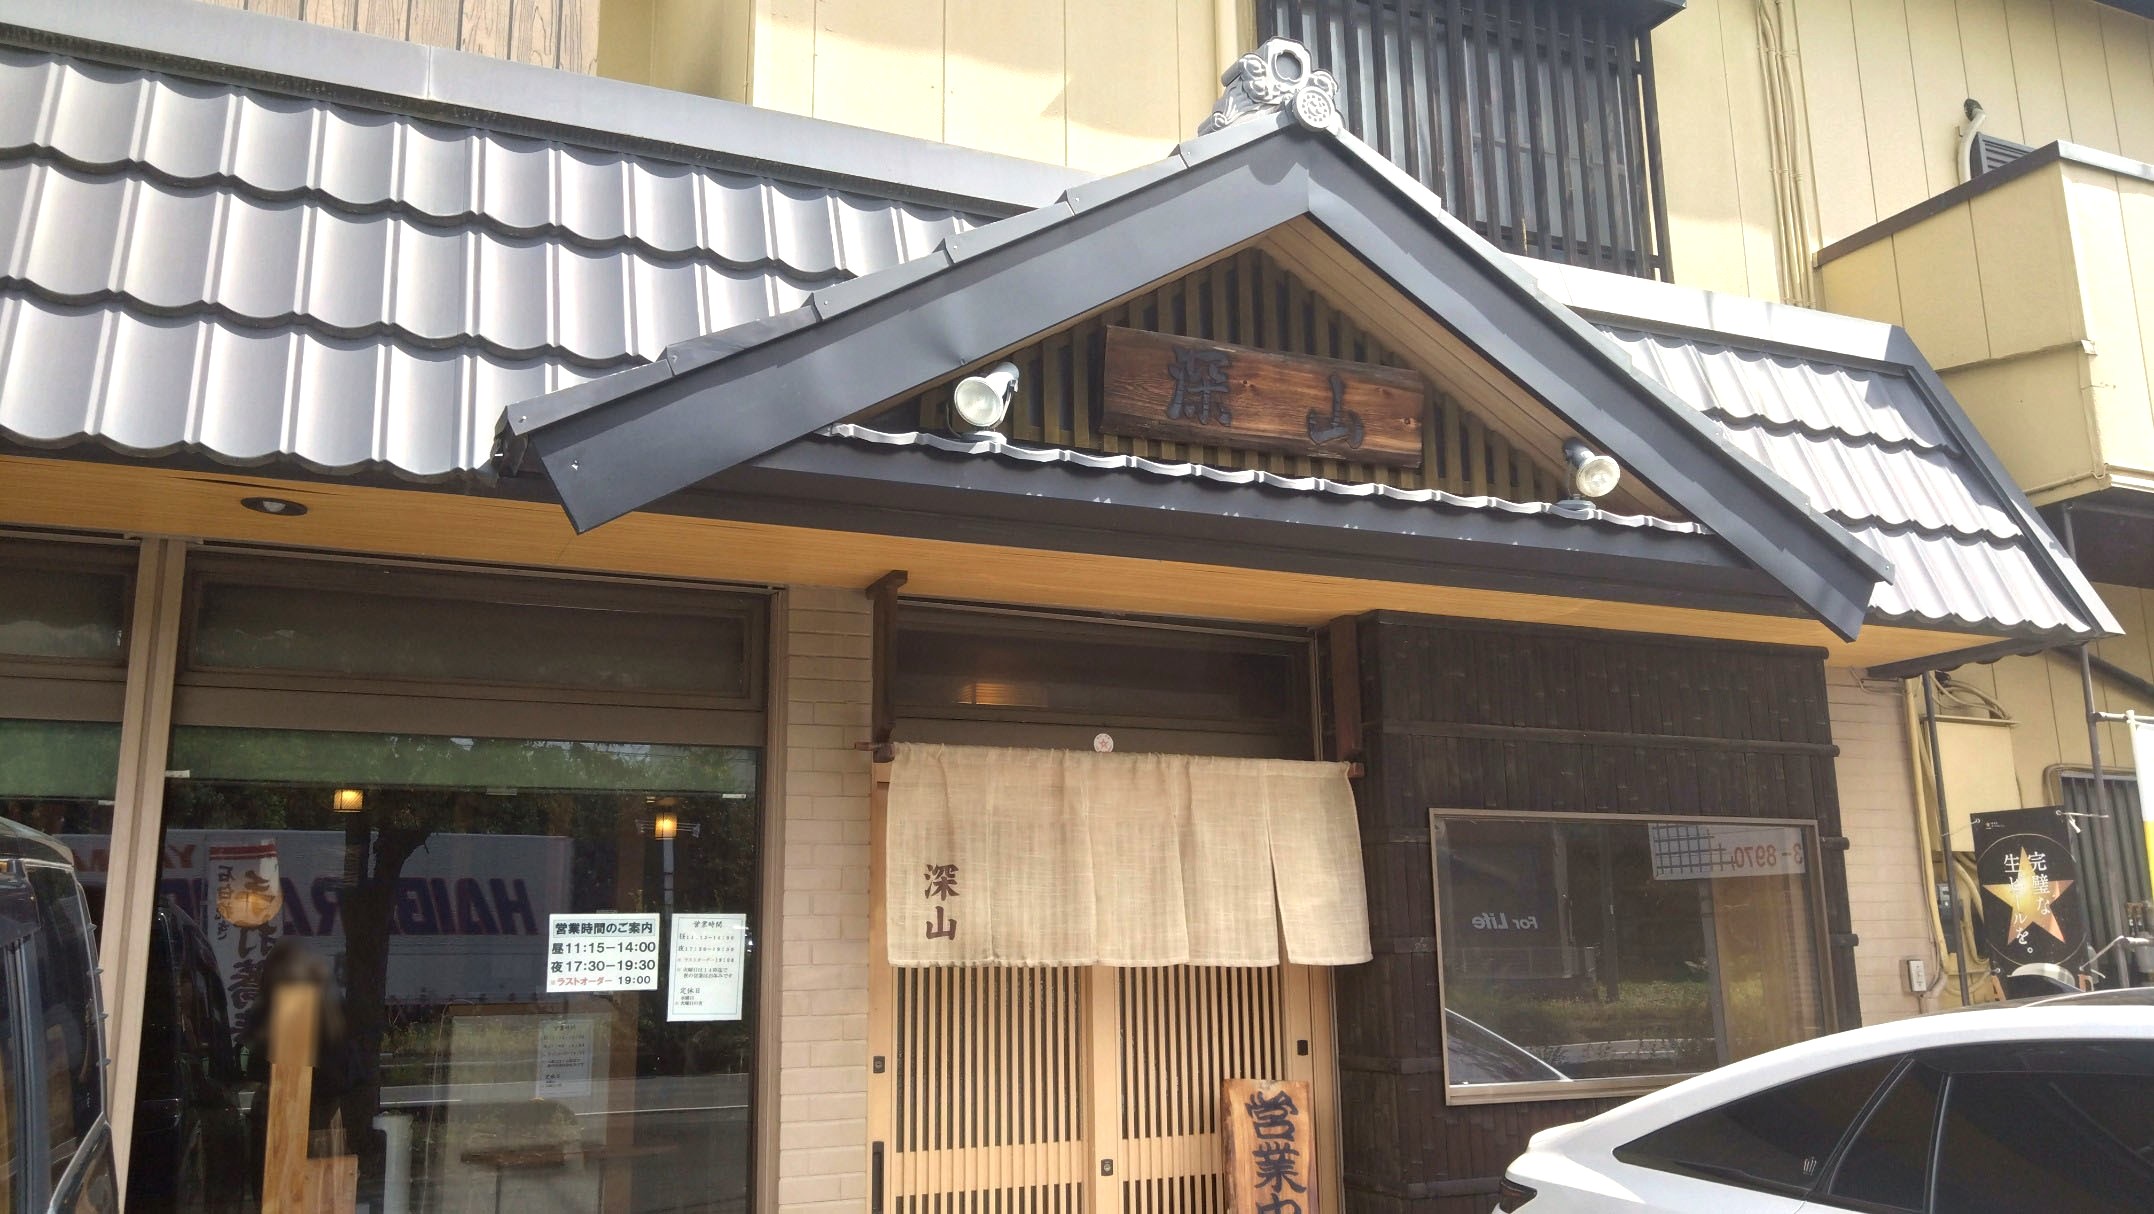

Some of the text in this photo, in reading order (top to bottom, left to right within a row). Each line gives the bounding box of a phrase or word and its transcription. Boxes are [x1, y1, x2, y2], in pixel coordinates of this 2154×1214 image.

[924, 863, 960, 941] 深山
[2027, 851, 2051, 915] 完璧な
[555, 921, 653, 935] 営業時間のご案内
[618, 975, 651, 984] 19:00
